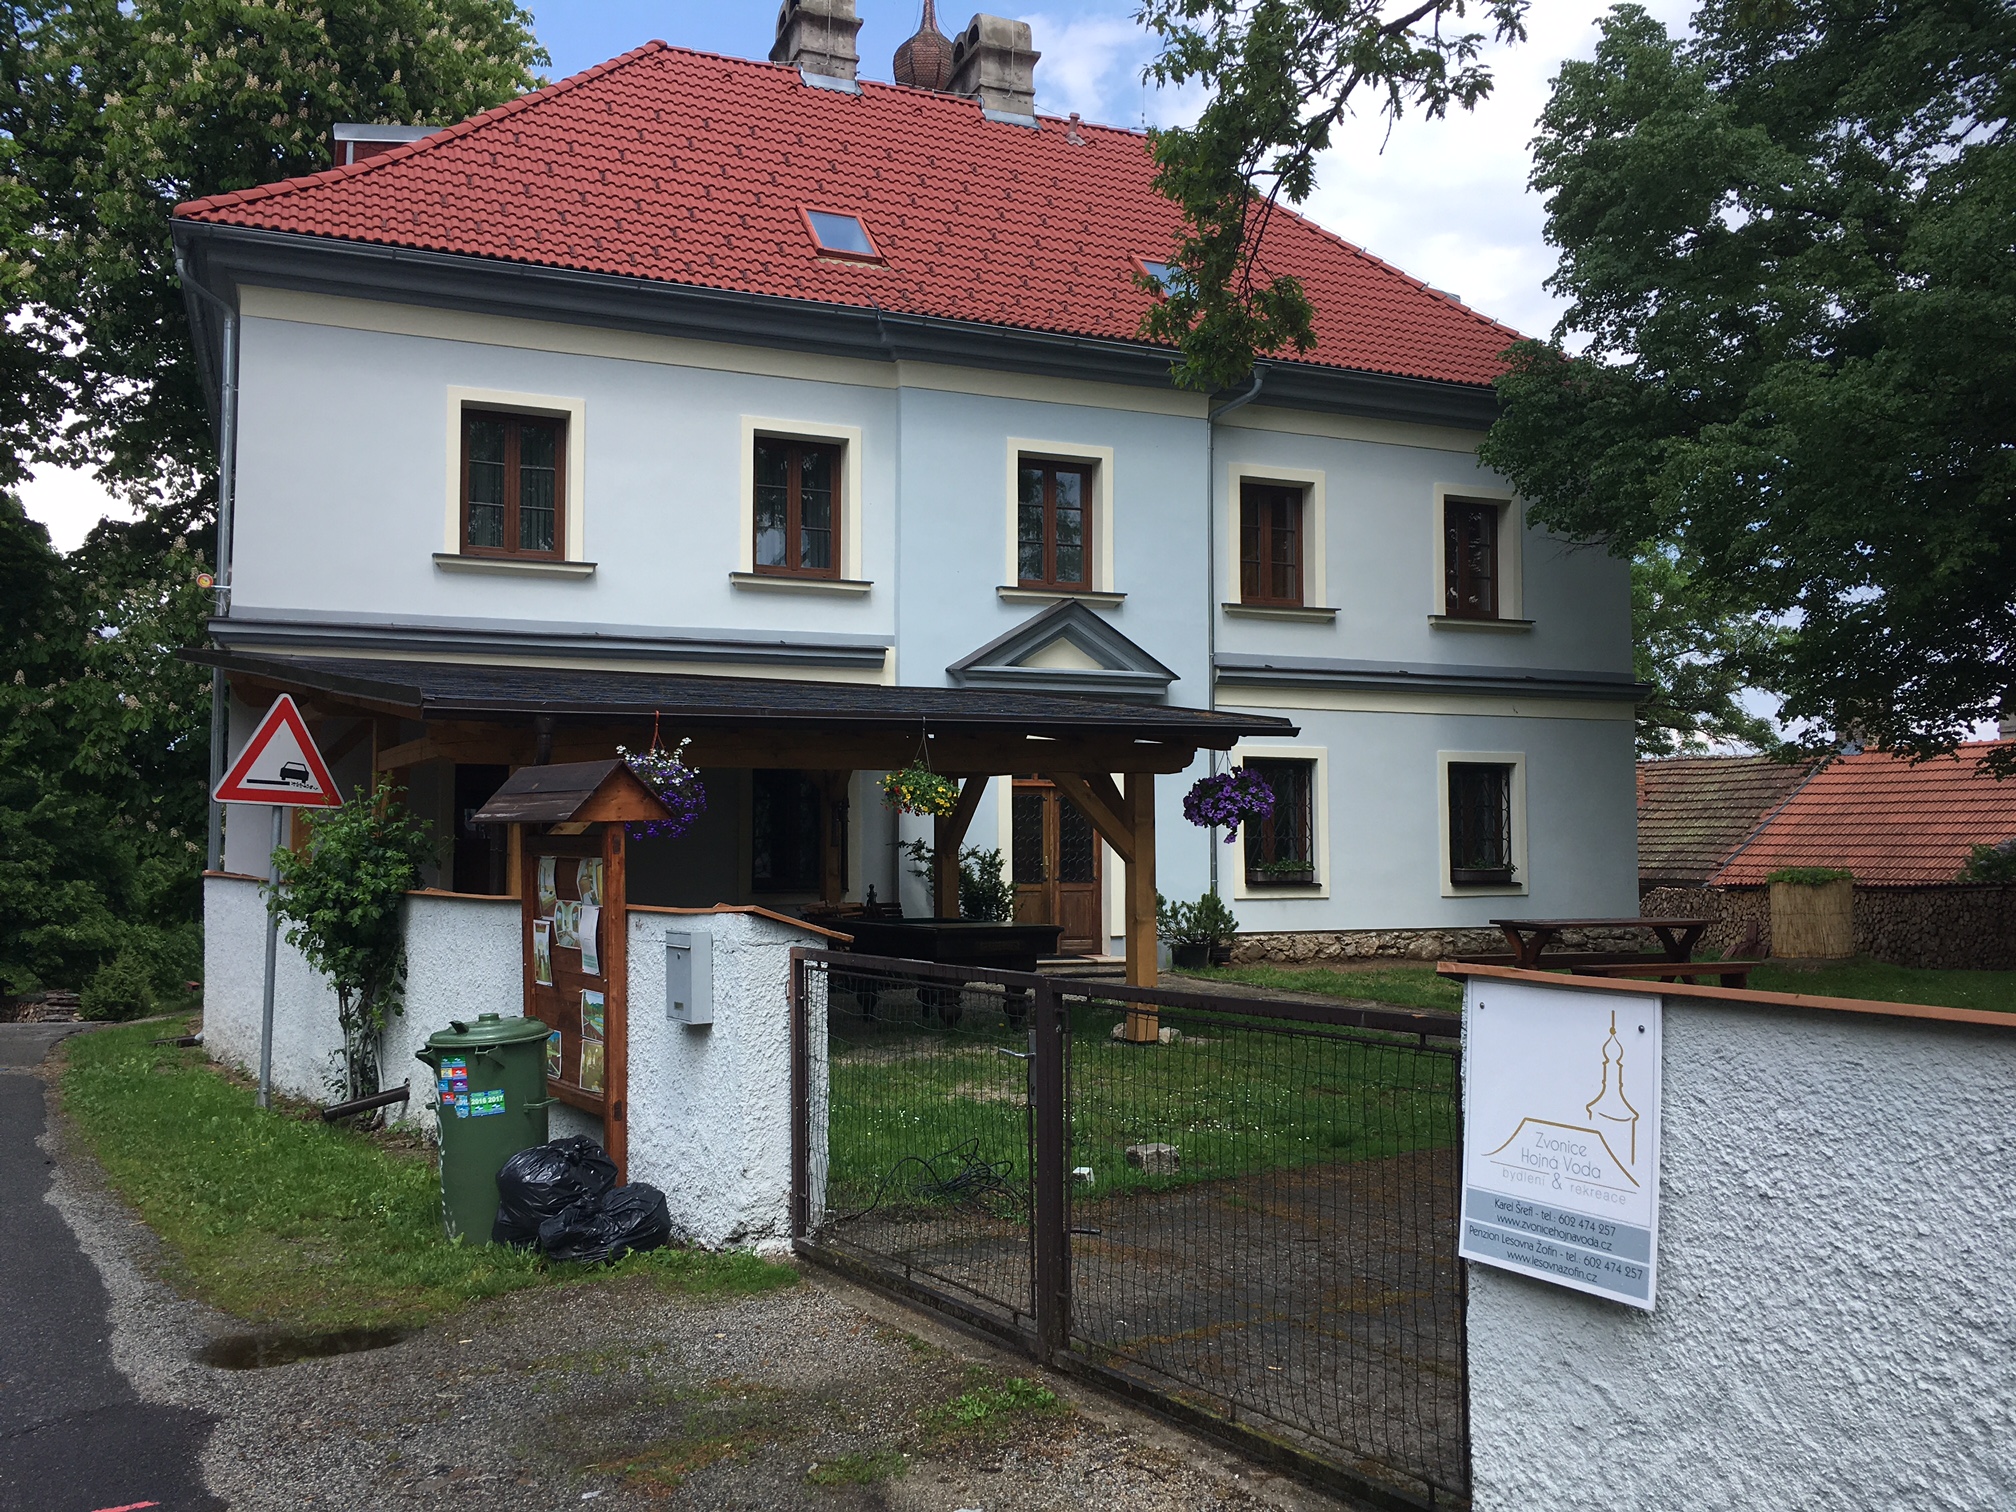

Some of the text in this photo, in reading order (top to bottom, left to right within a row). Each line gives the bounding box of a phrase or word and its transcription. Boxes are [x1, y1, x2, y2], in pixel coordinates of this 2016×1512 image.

[470, 1097, 487, 1105] 2016
[487, 1095, 504, 1104] 2017
[1535, 1131, 1588, 1158] Zvonice
[1521, 1147, 1601, 1179] Hojná Voda
[1502, 1167, 1626, 1205] bydlení & rekreace
[1494, 1198, 1514, 1212] Karel
[1541, 1210, 1556, 1222] tel.:
[1558, 1213, 1576, 1227] 602
[1578, 1219, 1596, 1232] 474
[1598, 1223, 1616, 1237] 257
[1496, 1214, 1613, 1252] www.zvonicehojnavoda.cz
[1469, 1225, 1500, 1242] Penzion
[1501, 1233, 1534, 1252] Lesovna
[1565, 1251, 1581, 1264] tel.:
[1583, 1255, 1602, 1270] 602
[1604, 1261, 1622, 1275] 474
[1624, 1266, 1643, 1280] 257
[1506, 1250, 1598, 1284] www.lesovnazofin.cz
